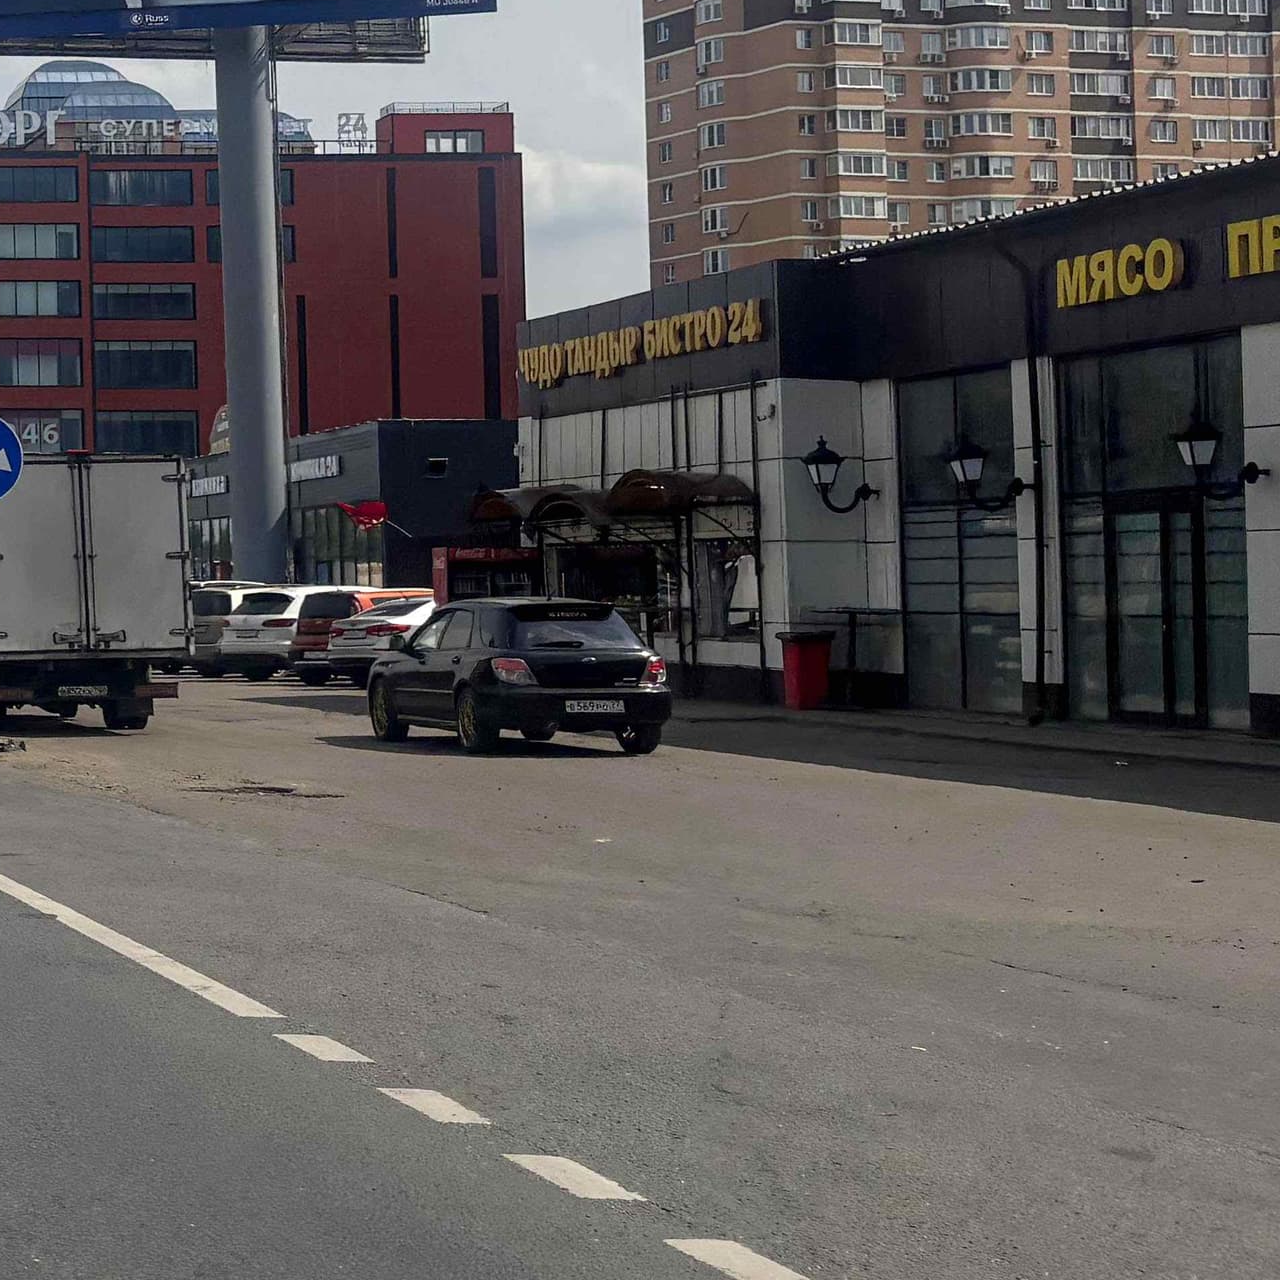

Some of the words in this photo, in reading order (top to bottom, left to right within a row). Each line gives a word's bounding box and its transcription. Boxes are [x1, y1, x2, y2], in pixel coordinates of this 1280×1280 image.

[1056, 238, 1176, 309] МЯСО
[518, 342, 563, 390] ЧУДО
[564, 326, 640, 380] ТАНДЫР
[643, 306, 726, 360] БИСТРО
[727, 298, 762, 345] 24
